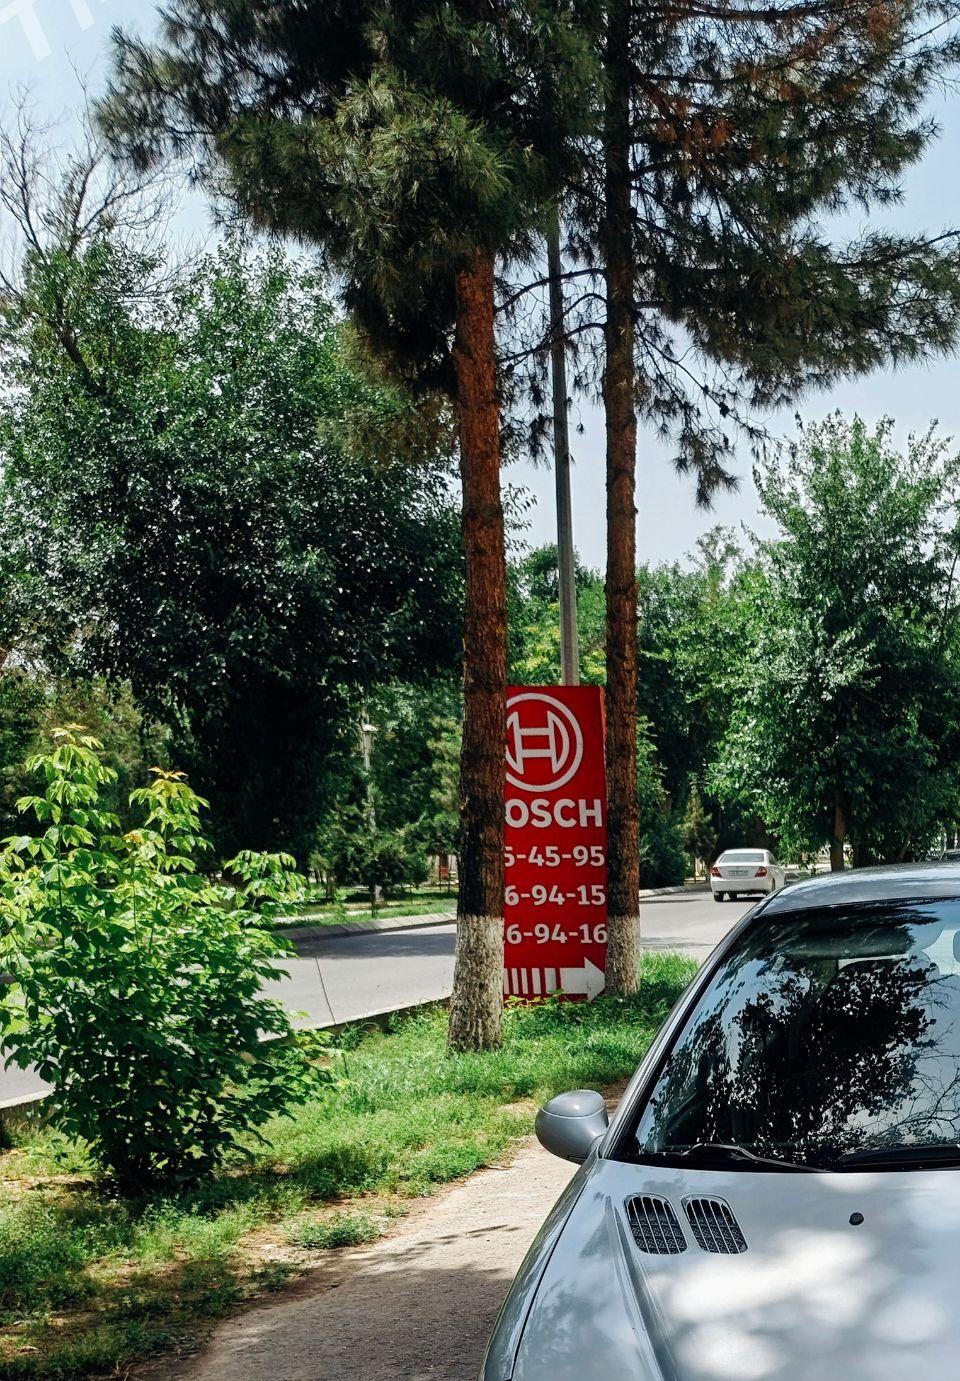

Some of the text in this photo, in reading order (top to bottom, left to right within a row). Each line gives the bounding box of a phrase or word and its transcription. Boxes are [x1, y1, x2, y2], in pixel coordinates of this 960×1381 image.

[505, 798, 603, 828] OSCH
[504, 846, 605, 867] 5-45-95
[504, 885, 606, 906] 6-94-15
[503, 923, 608, 945] 6-94-16
